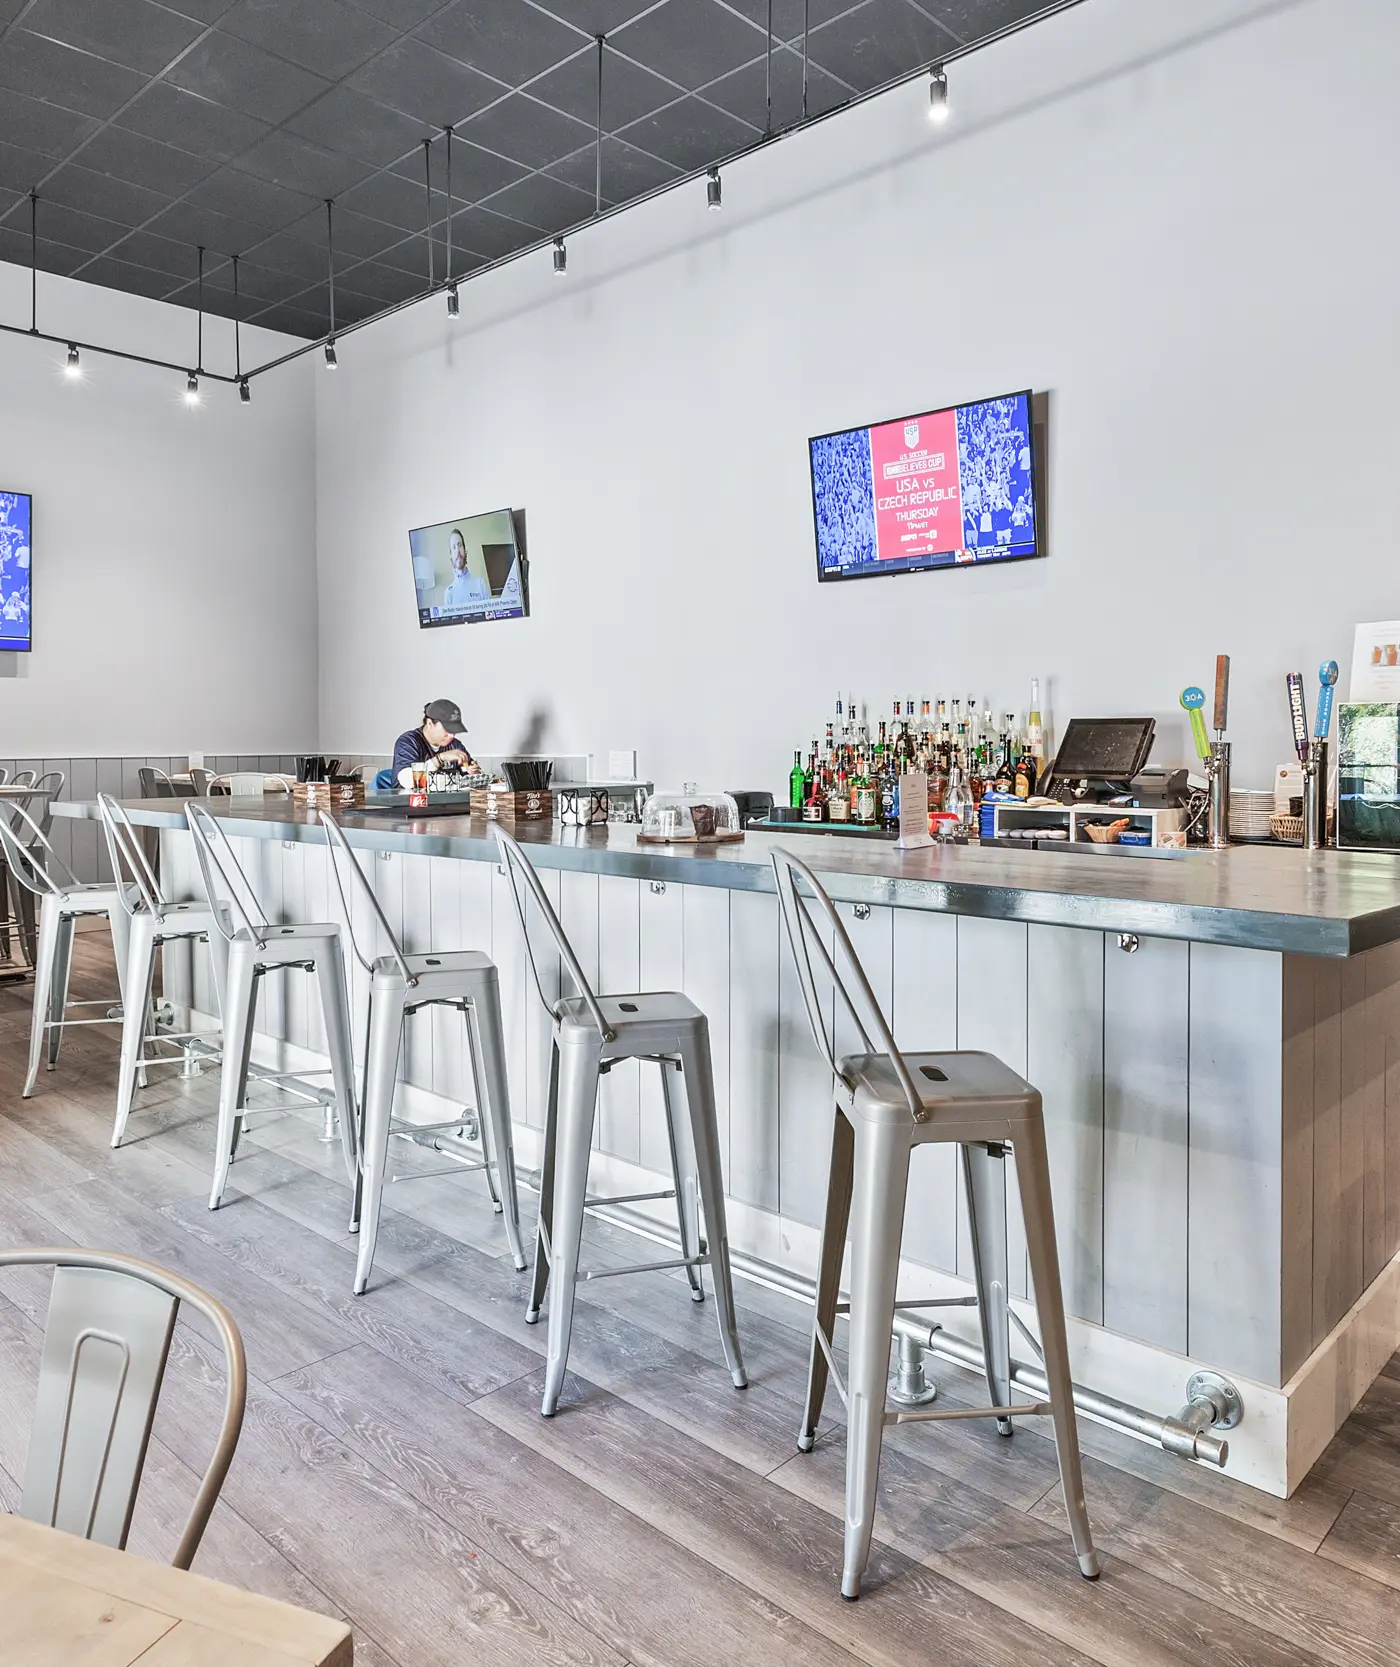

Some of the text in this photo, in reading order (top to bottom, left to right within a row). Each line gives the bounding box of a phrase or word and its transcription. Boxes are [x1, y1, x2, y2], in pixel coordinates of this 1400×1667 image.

[928, 457, 942, 468] CUP
[896, 478, 920, 493] USA
[878, 486, 957, 511] CZECH REPUBLIC
[895, 507, 939, 523] THURSDAY
[1289, 684, 1306, 740] BUD LIGHT
